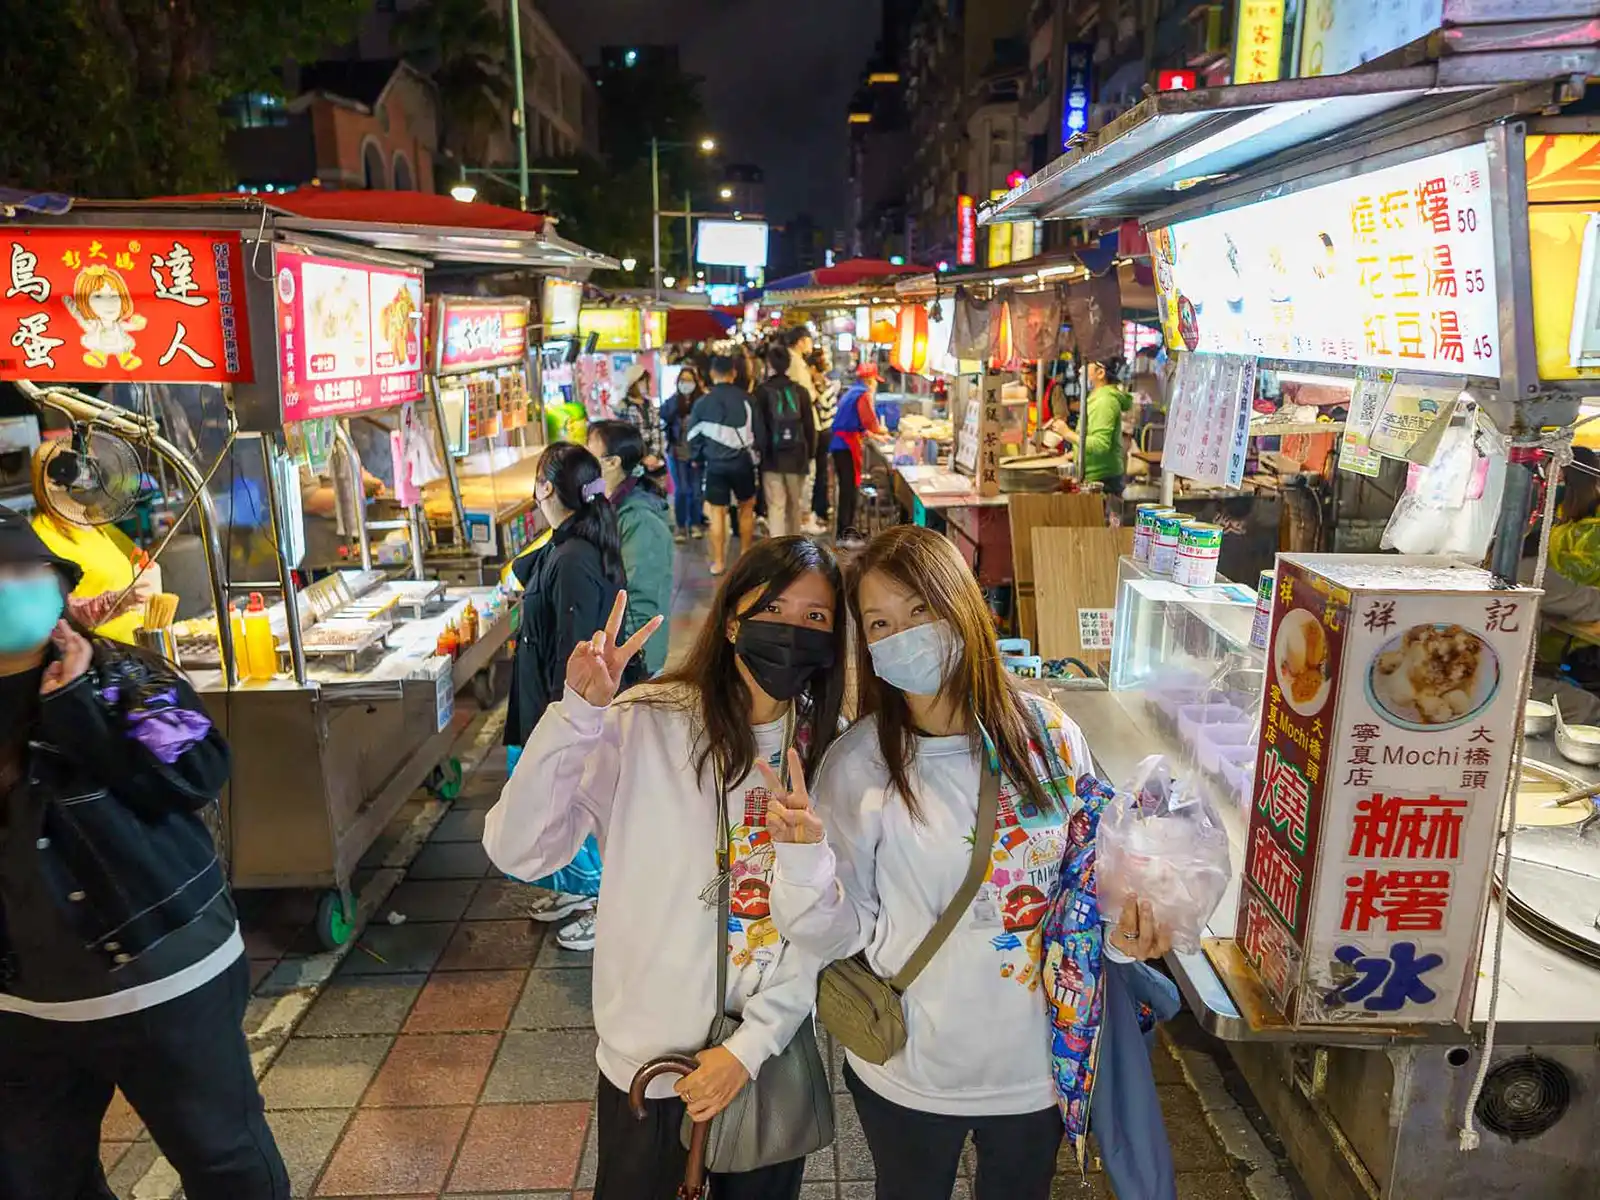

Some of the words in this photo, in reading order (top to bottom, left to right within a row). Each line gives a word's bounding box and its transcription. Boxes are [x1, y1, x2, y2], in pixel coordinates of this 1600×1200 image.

[1457, 208, 1477, 233] 50
[1356, 244, 1458, 298] 花生湯
[1465, 268, 1486, 293] 55
[1363, 310, 1465, 363] 紅豆湯
[1473, 334, 1493, 360] 45
[1362, 601, 1398, 636] 祥
[1484, 601, 1520, 634] 記
[1278, 711, 1311, 752] Mochi
[1343, 723, 1382, 788] 寧夏店
[1382, 744, 1462, 767] Mochi
[1458, 724, 1496, 790] 大橋頭
[1028, 862, 1060, 887] TAIWA
